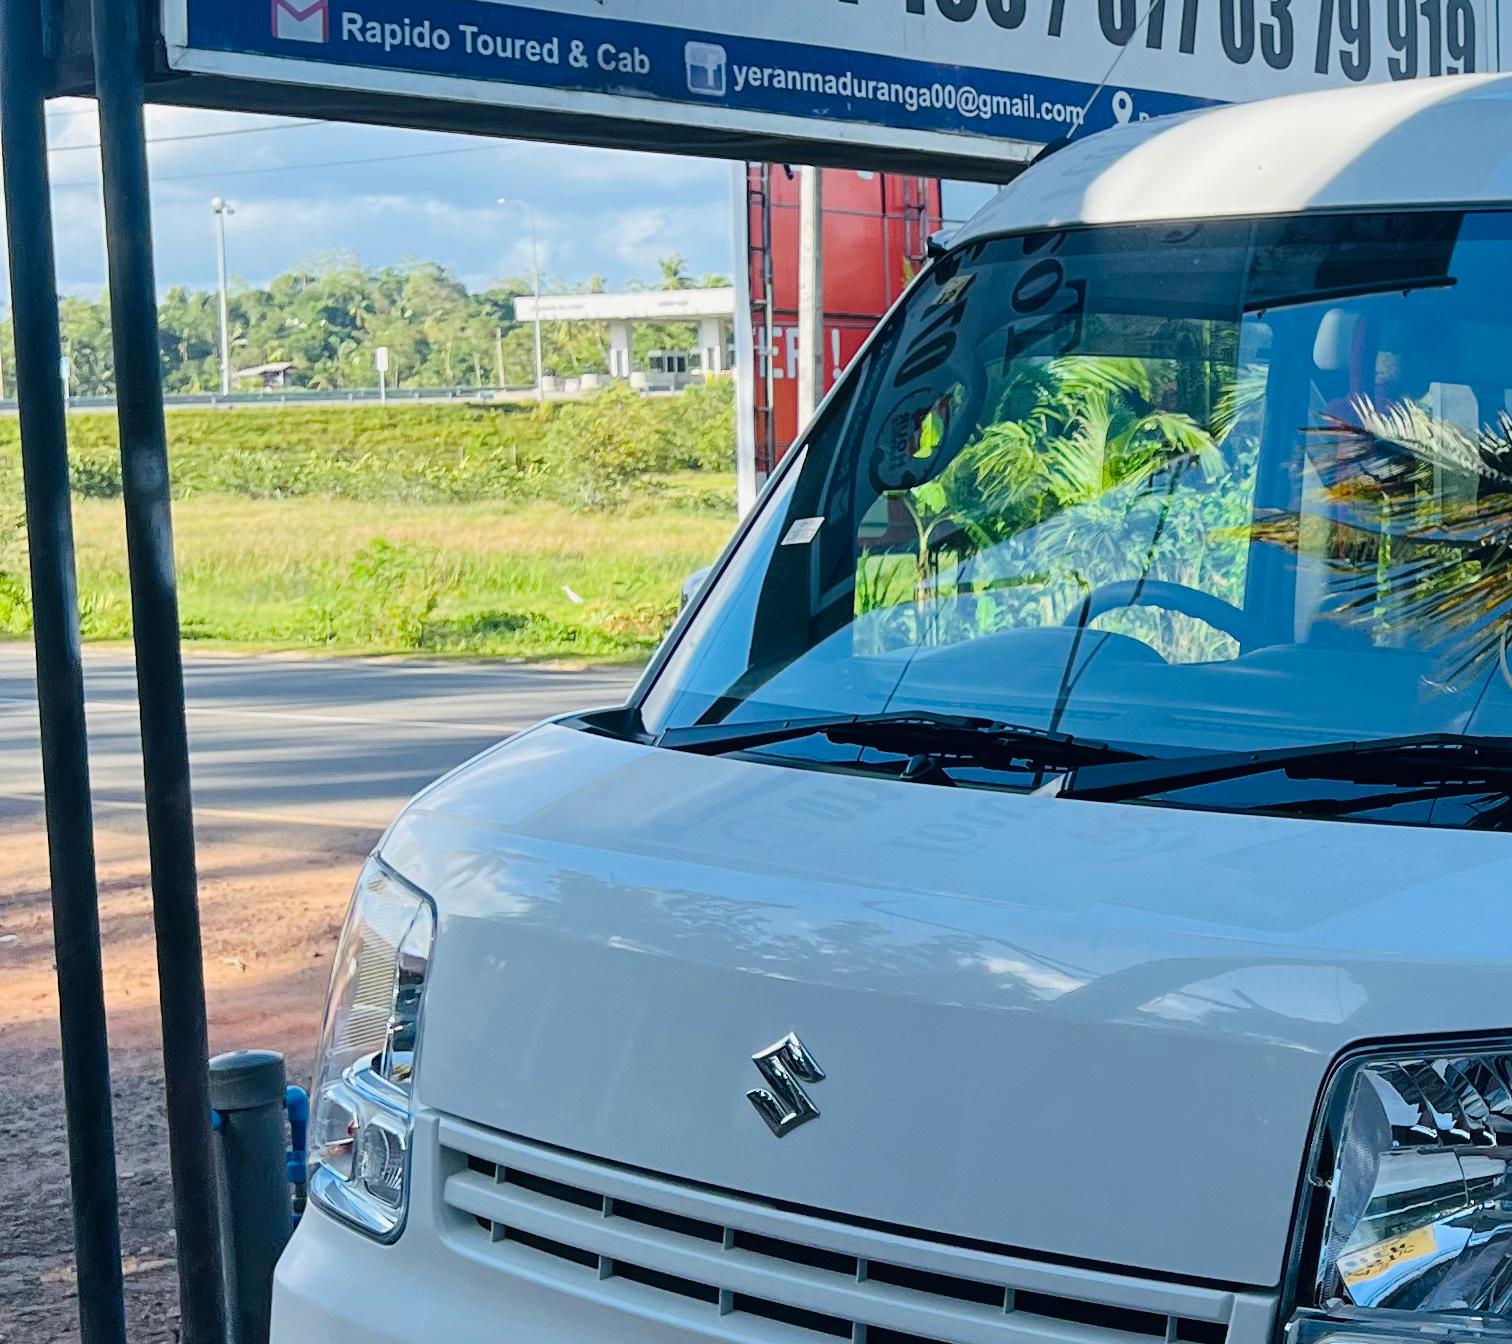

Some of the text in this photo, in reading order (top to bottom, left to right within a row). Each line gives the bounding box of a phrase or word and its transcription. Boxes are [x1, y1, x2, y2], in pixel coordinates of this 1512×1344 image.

[342, 12, 650, 75] Rapido Toured & Cab
[733, 63, 1085, 124] yeranmaduranga00@gmail.com
